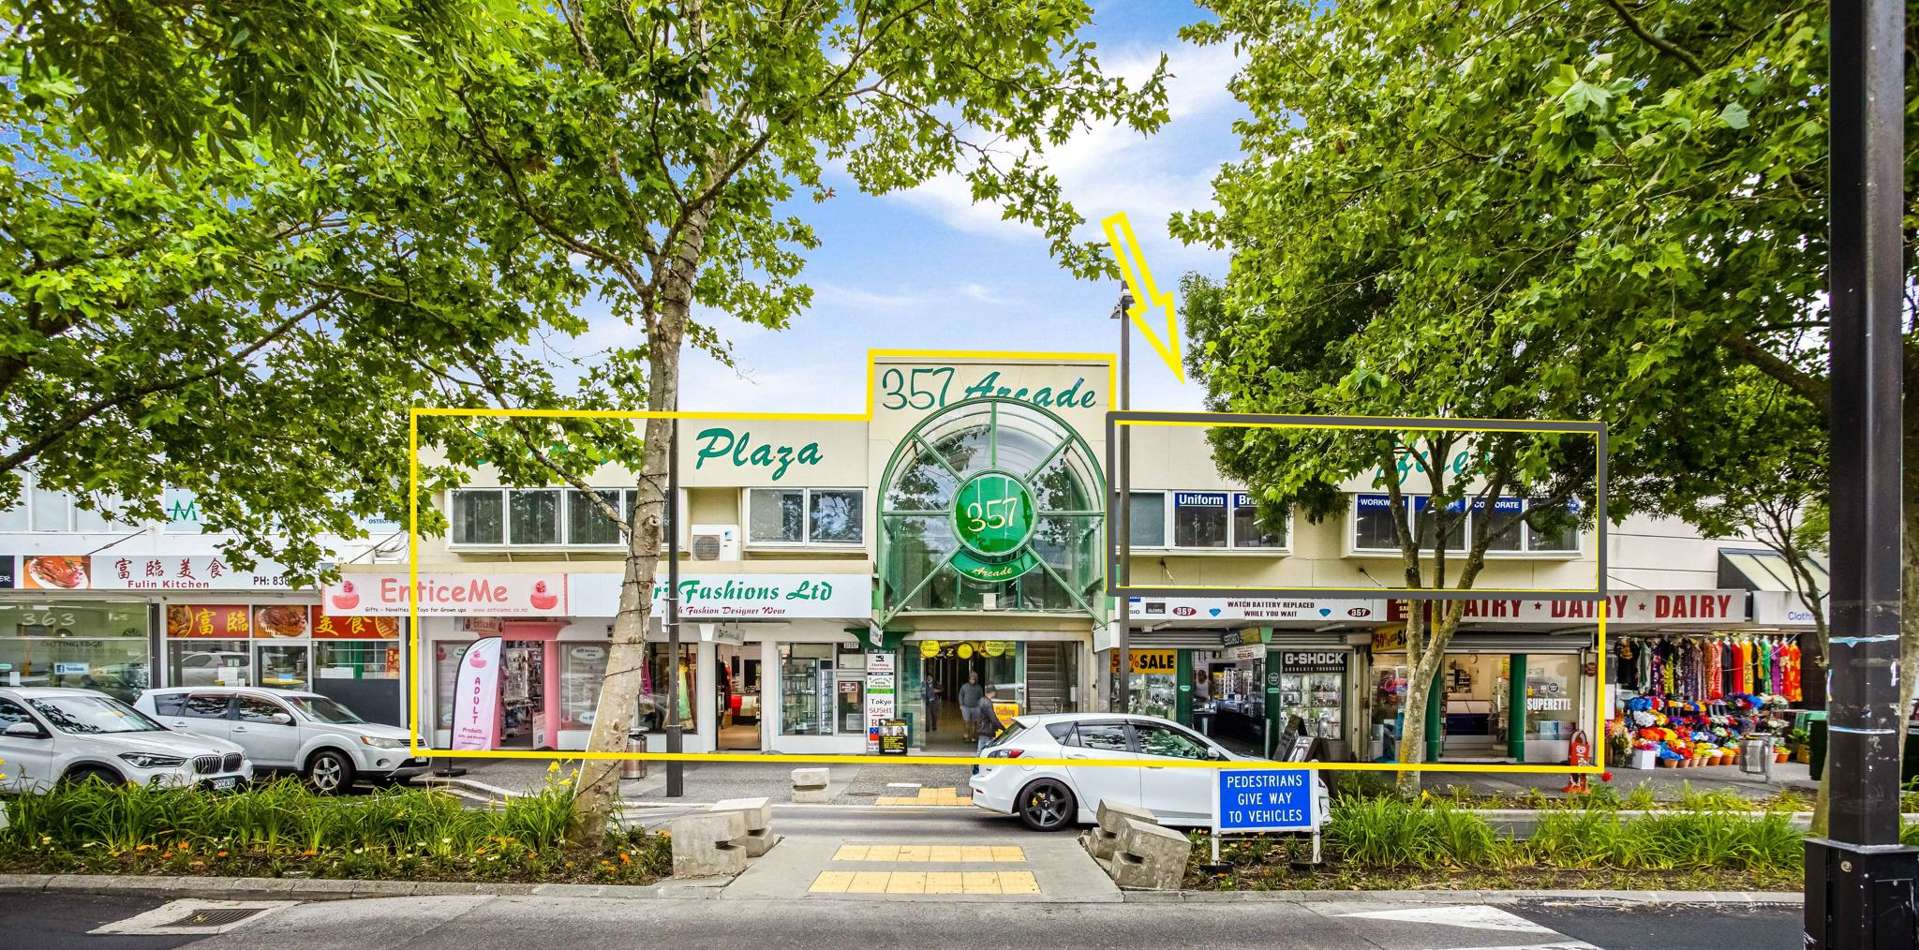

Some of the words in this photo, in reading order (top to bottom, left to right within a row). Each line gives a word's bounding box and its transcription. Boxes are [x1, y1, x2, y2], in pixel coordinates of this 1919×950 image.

[882, 367, 955, 411] 357
[964, 371, 1096, 409] Arcade
[695, 427, 823, 481] Plaza
[1178, 494, 1224, 505] Uniform
[1474, 501, 1519, 509] COORATE
[966, 497, 1017, 532] 357
[114, 557, 227, 580] 富臨美食
[128, 580, 157, 588] Fulin
[162, 580, 209, 588] Kitchen
[253, 576, 270, 585] PH:
[381, 577, 508, 603] EnticeMe
[678, 580, 779, 604] Fashions
[785, 580, 832, 602] Ltd
[685, 606, 719, 615] Fashion
[722, 606, 759, 616] Designer
[762, 606, 786, 615] Wear
[1351, 608, 1367, 616] 357
[1446, 599, 1523, 618] AIRY
[1655, 595, 1731, 619] DAIRY
[21, 612, 76, 626] 363
[1112, 654, 1139, 668] 5%
[1140, 654, 1175, 669] SALE
[1285, 652, 1344, 664] G-SHOCK
[472, 677, 481, 725] ADULT
[1527, 697, 1572, 711] SUPERETTE
[1227, 774, 1303, 788] PEDESTRIANS
[1238, 793, 1263, 805] GIVE
[1269, 792, 1292, 805] WAY
[1229, 811, 1242, 823] TO
[1249, 809, 1303, 822] VEHICLES
